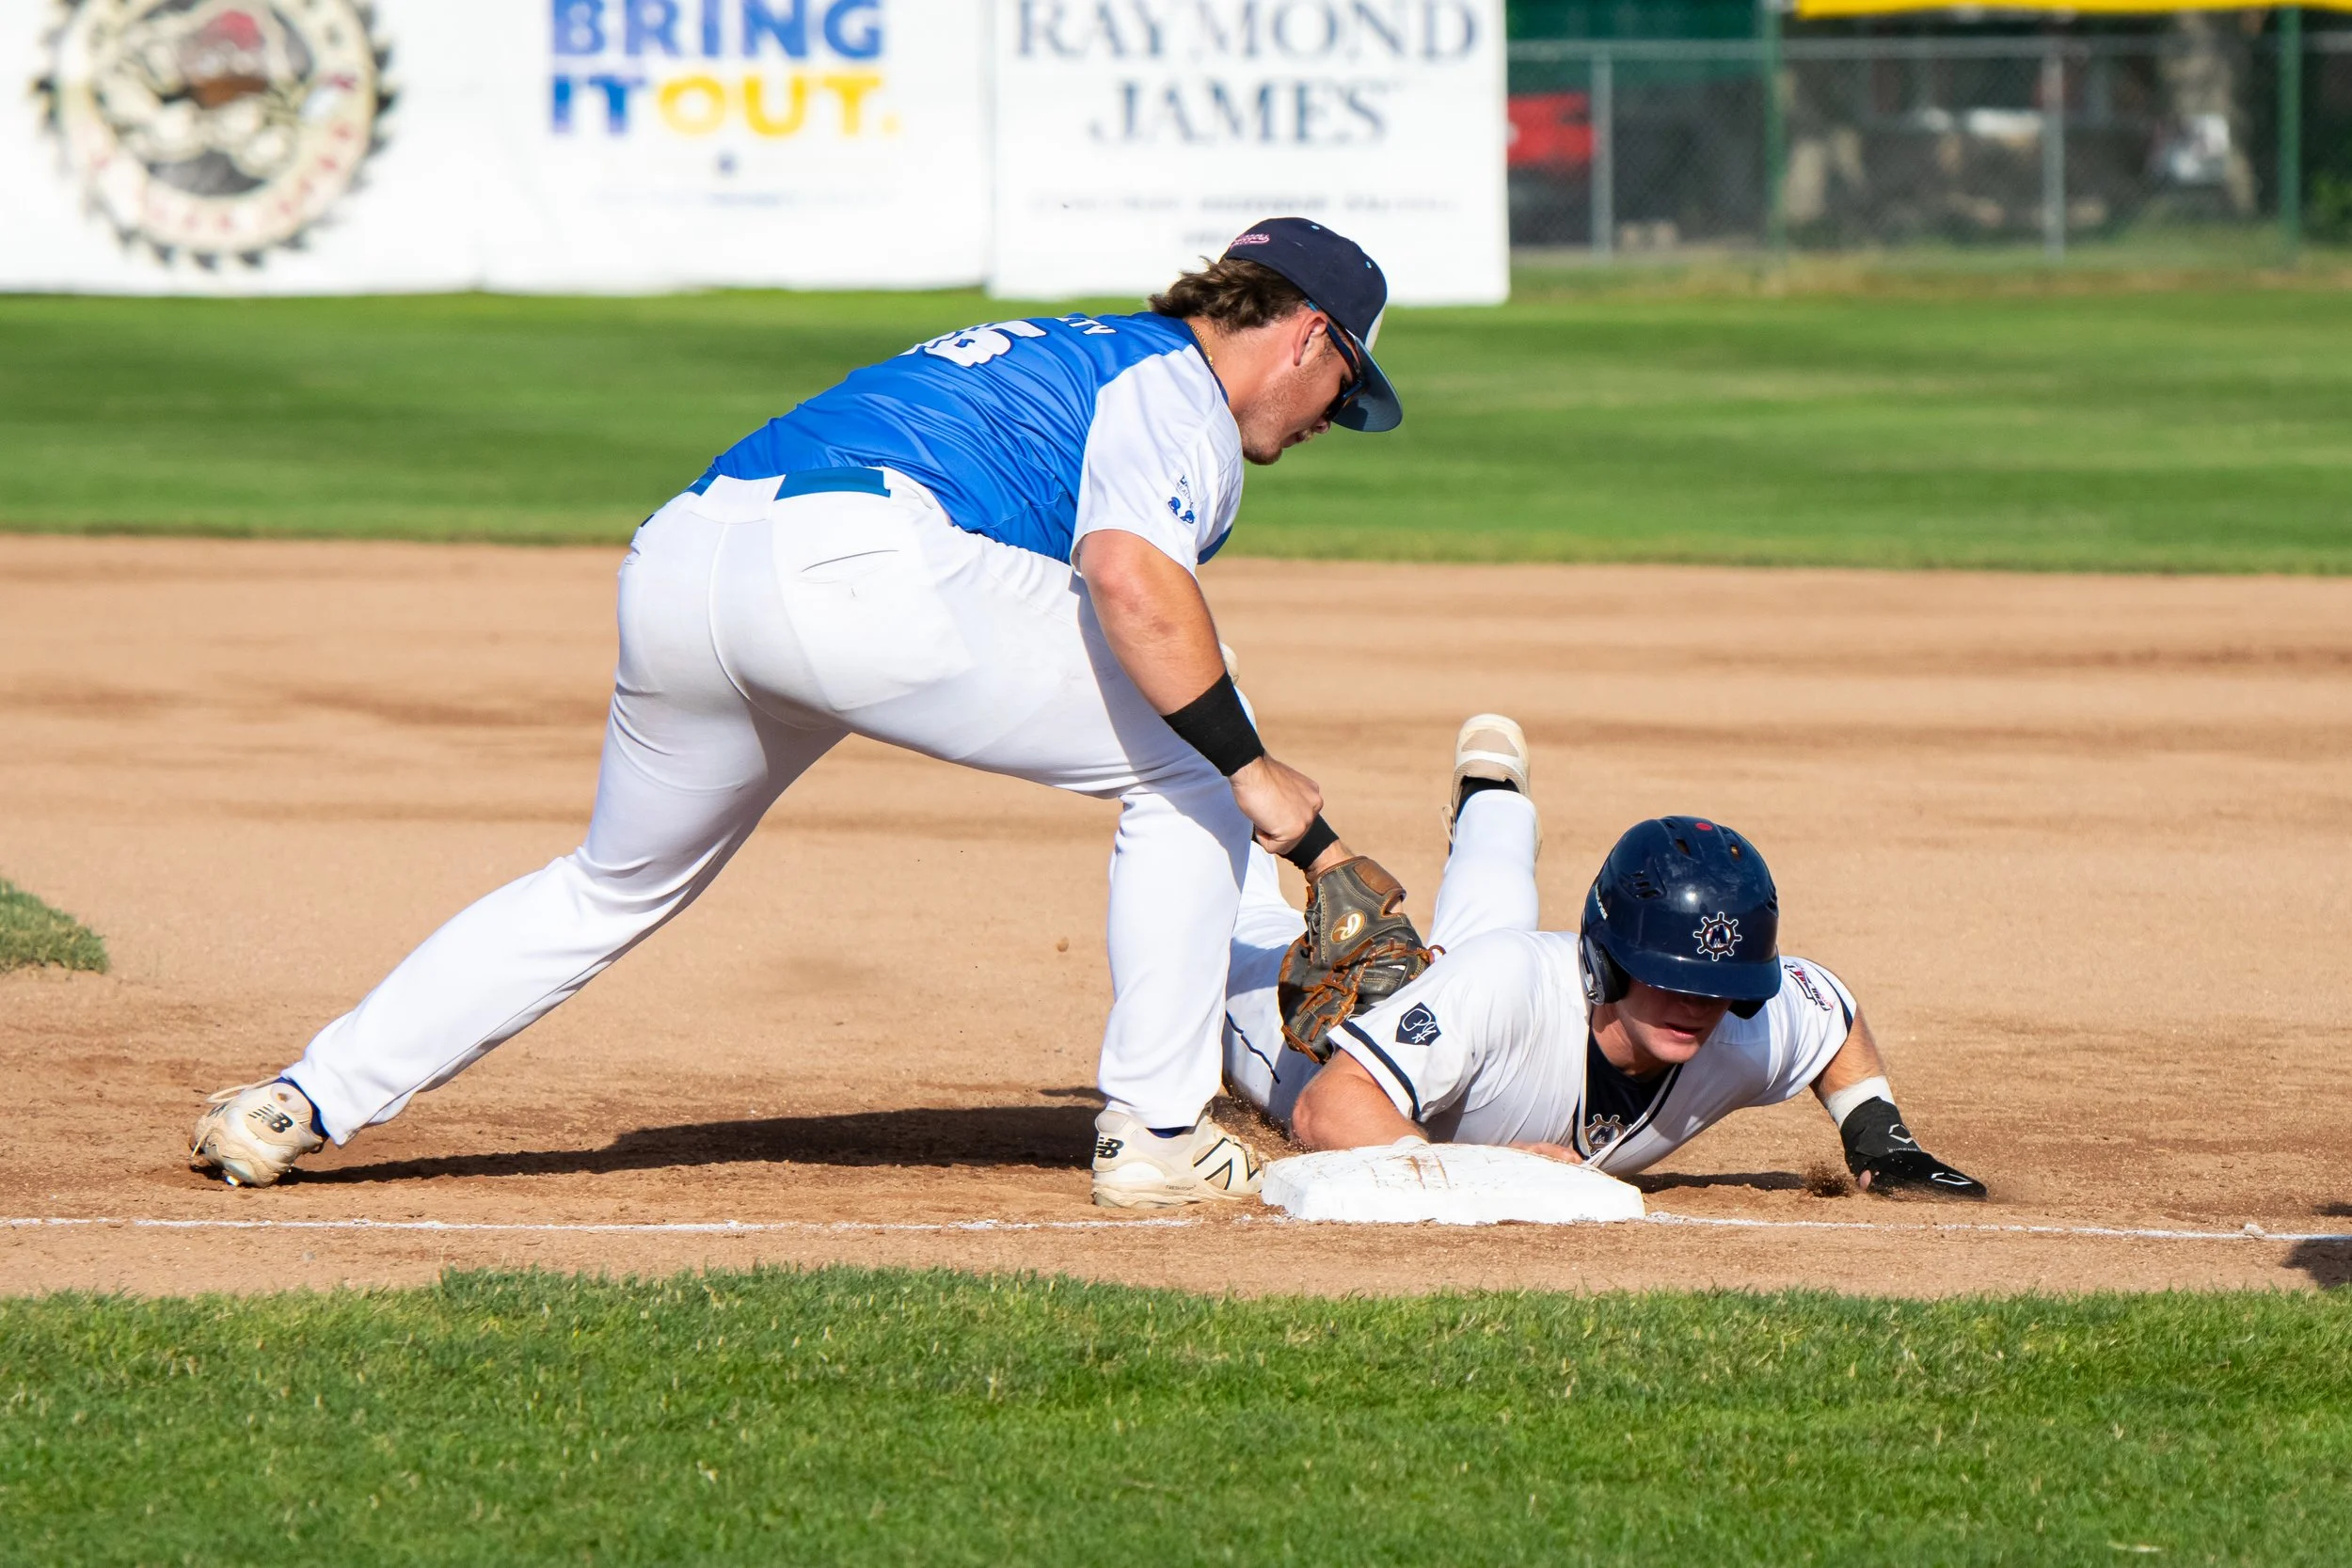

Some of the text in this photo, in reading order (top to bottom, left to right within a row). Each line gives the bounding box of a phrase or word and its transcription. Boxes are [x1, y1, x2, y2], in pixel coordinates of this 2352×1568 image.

[550, 0, 882, 58] BRING
[1016, 0, 1478, 56] RAYMOND
[1087, 79, 1388, 144] JAMES
